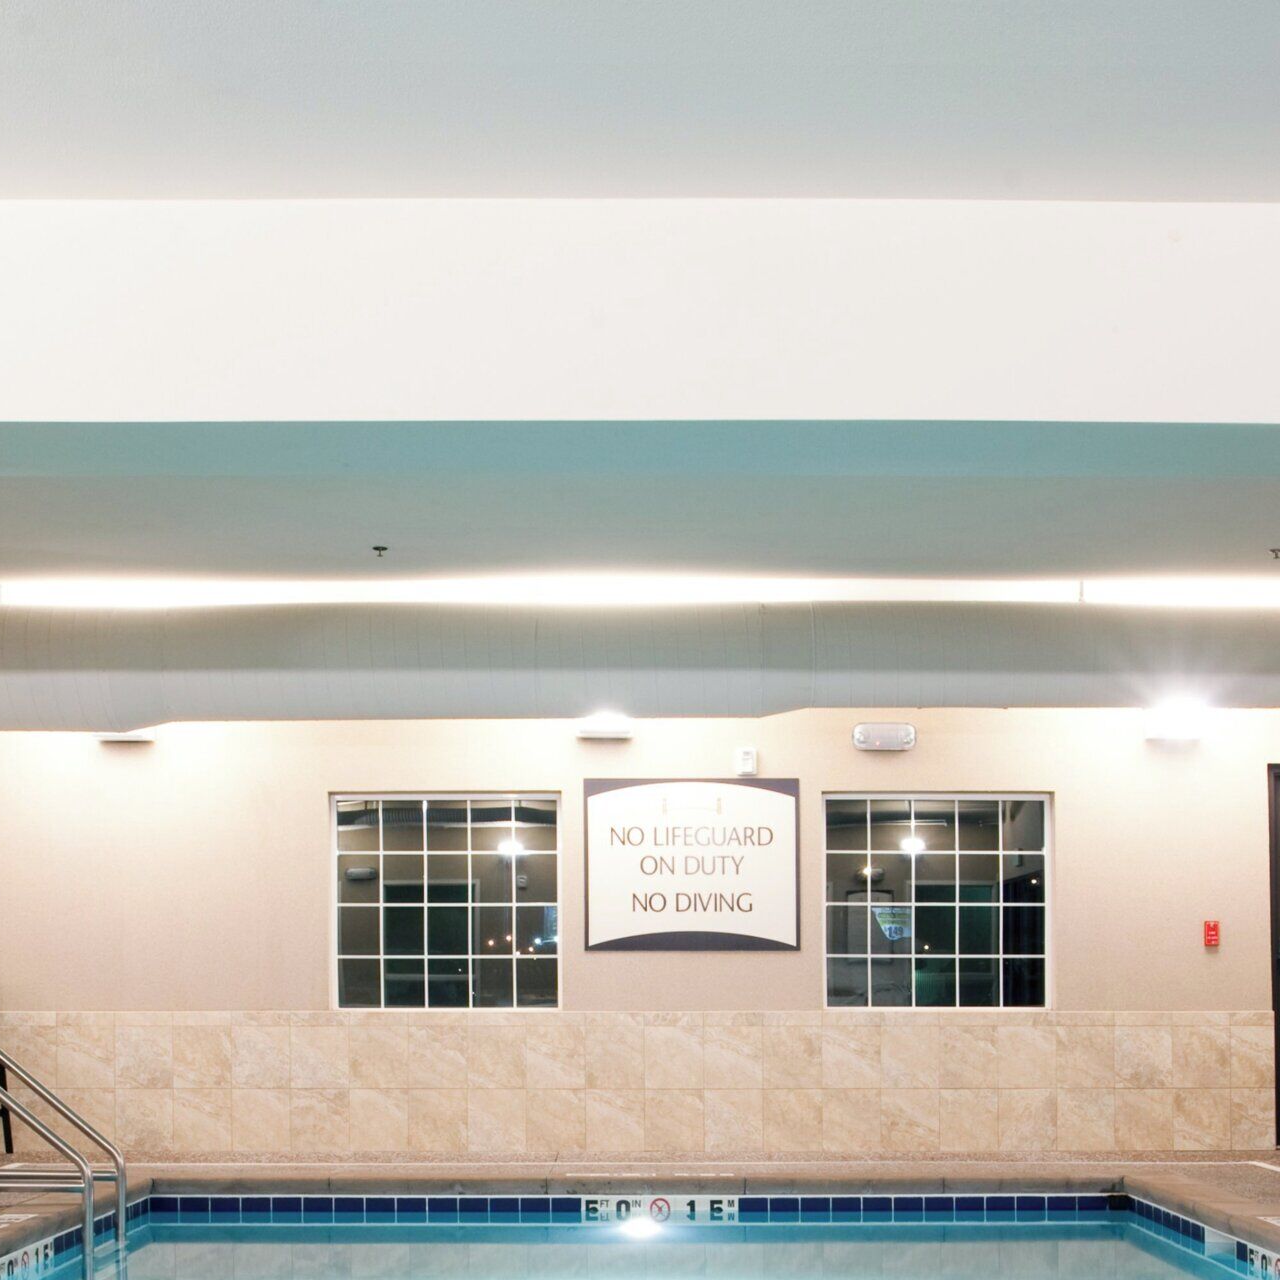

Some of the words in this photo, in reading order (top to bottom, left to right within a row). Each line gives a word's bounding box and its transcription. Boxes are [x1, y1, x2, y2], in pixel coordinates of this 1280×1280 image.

[610, 826, 645, 847] NO
[653, 826, 774, 847] LIFEGUARD
[639, 855, 675, 876] ON
[684, 855, 745, 876] DUTY
[632, 892, 667, 913] NO
[675, 892, 754, 913] DIVING
[585, 1199, 599, 1213] 5
[599, 1200, 610, 1208] FT
[631, 1200, 642, 1208] IN
[727, 1200, 735, 1208] M
